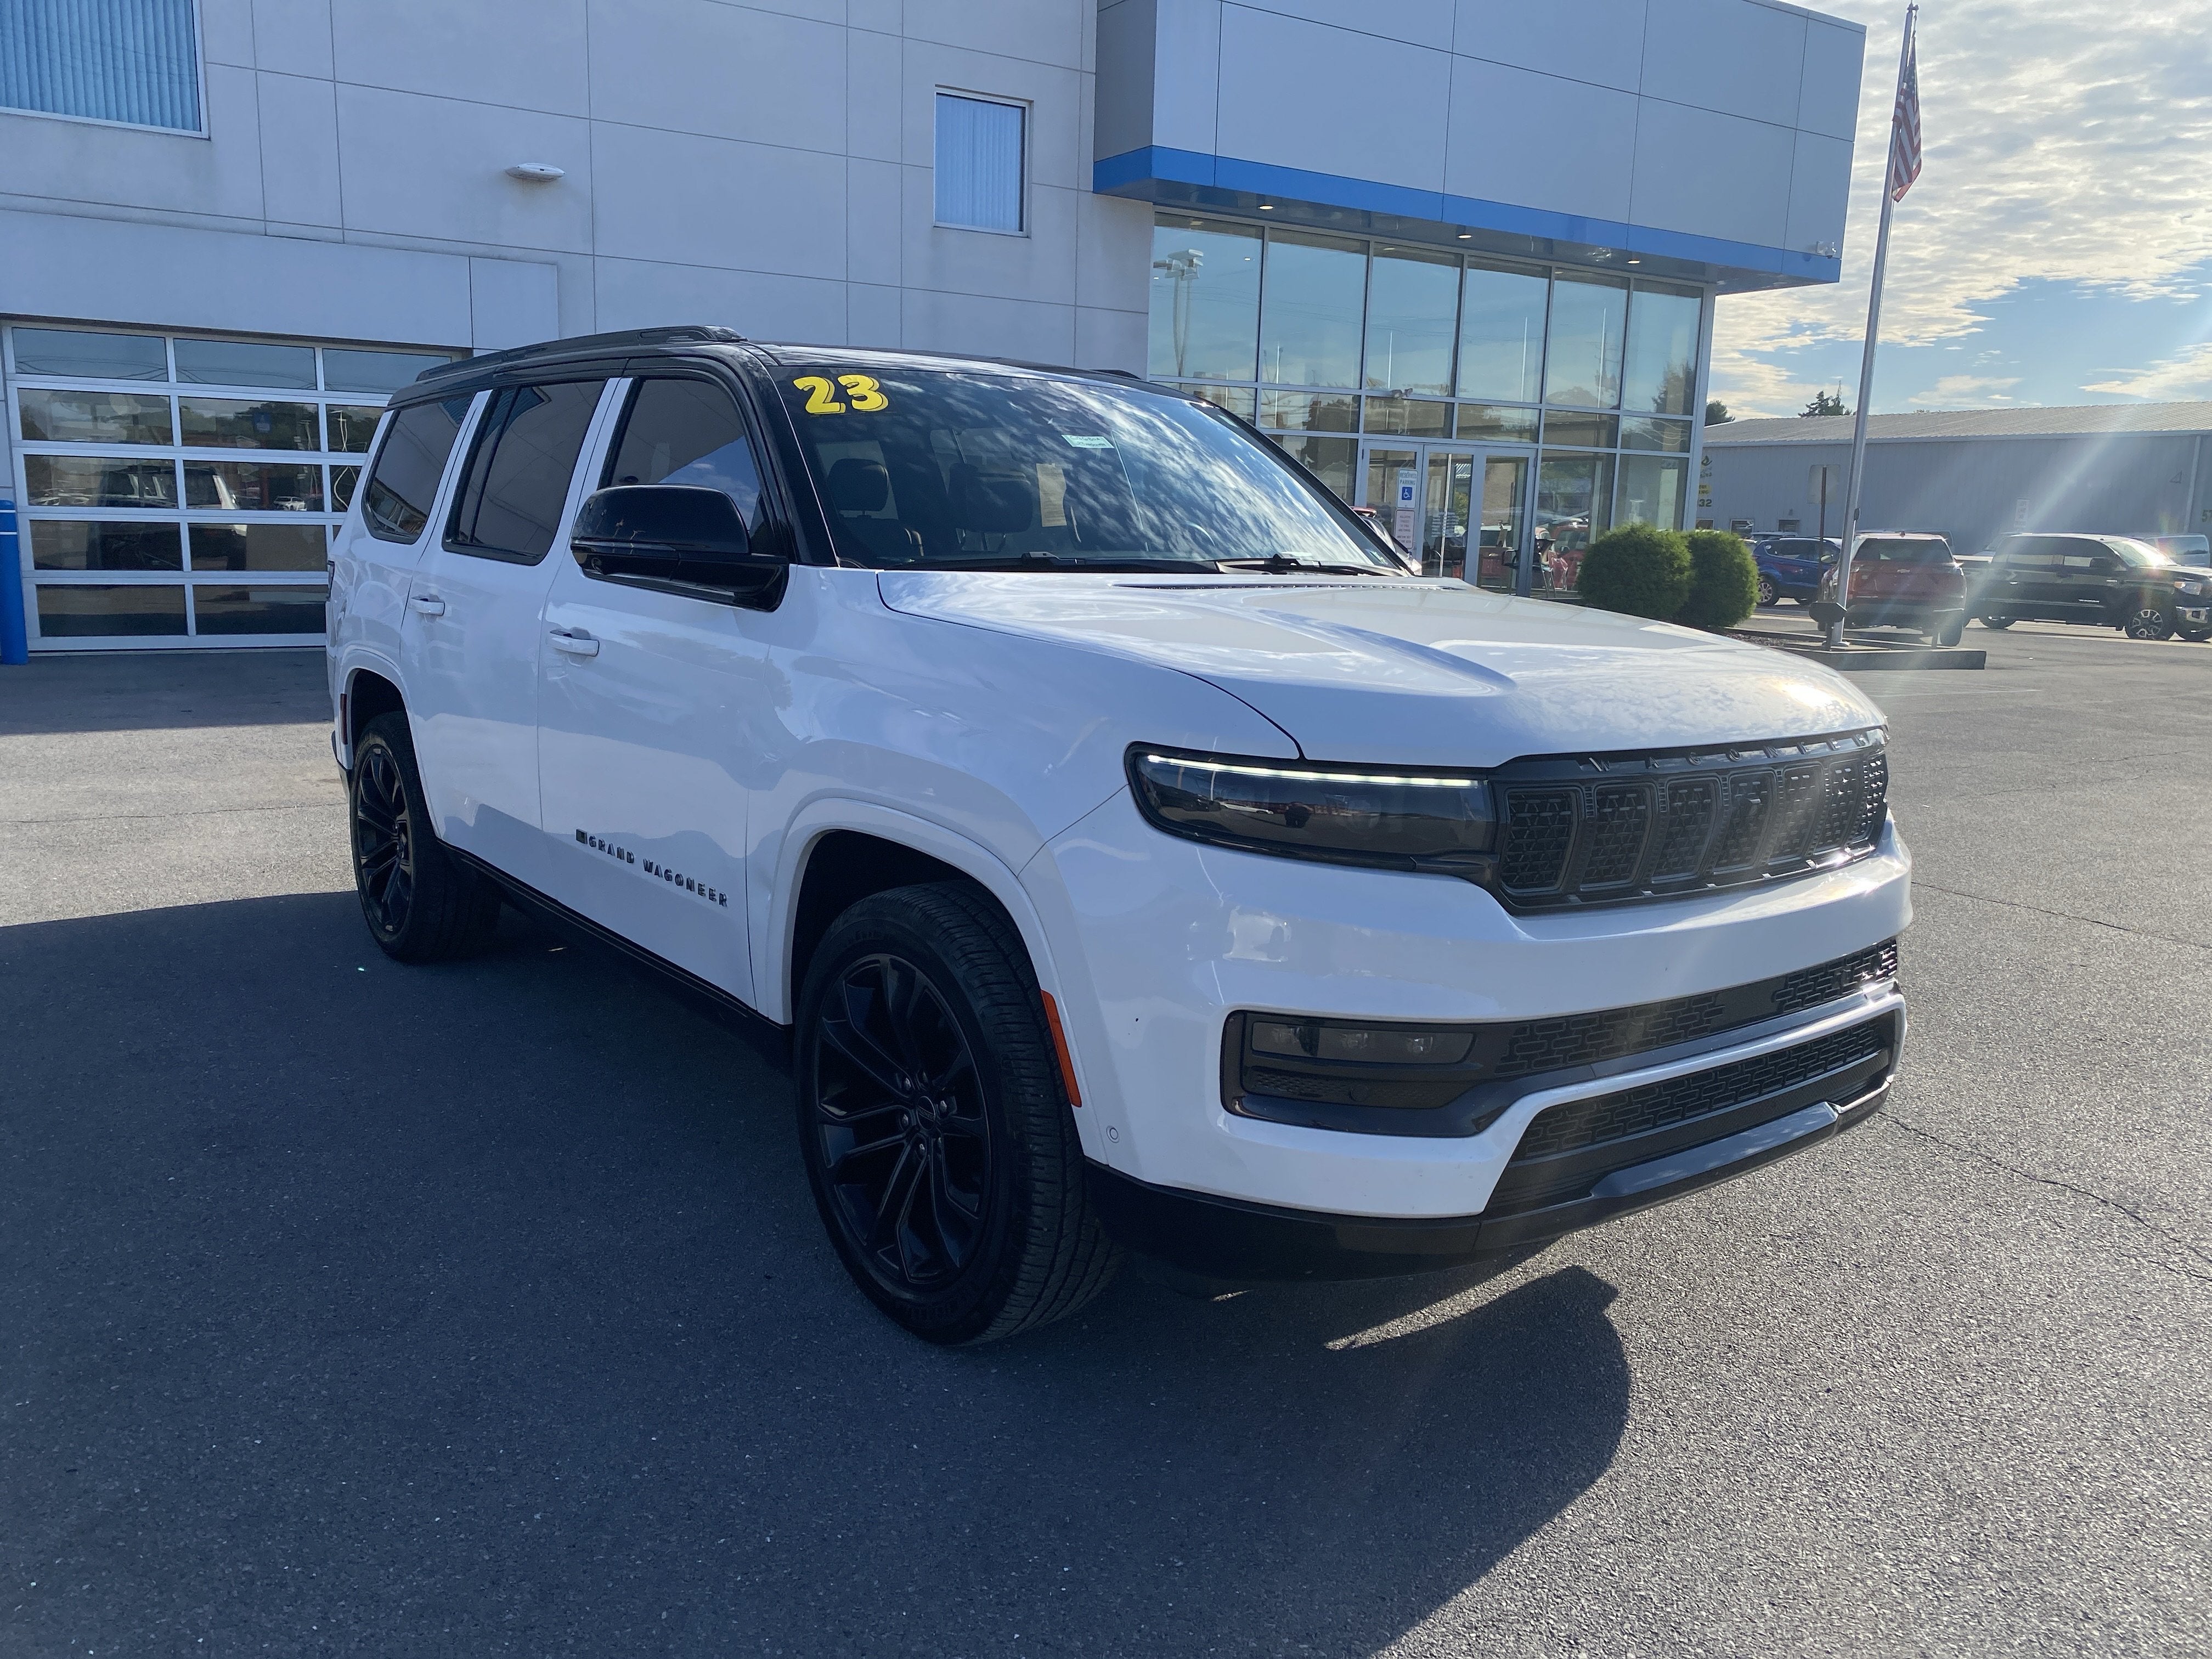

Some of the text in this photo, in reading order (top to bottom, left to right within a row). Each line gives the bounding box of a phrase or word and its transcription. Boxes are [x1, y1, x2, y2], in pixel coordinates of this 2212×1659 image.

[793, 374, 889, 415] 23
[1589, 733, 1869, 772] WAGONEER
[589, 834, 727, 907] GRAND WAGONEER
